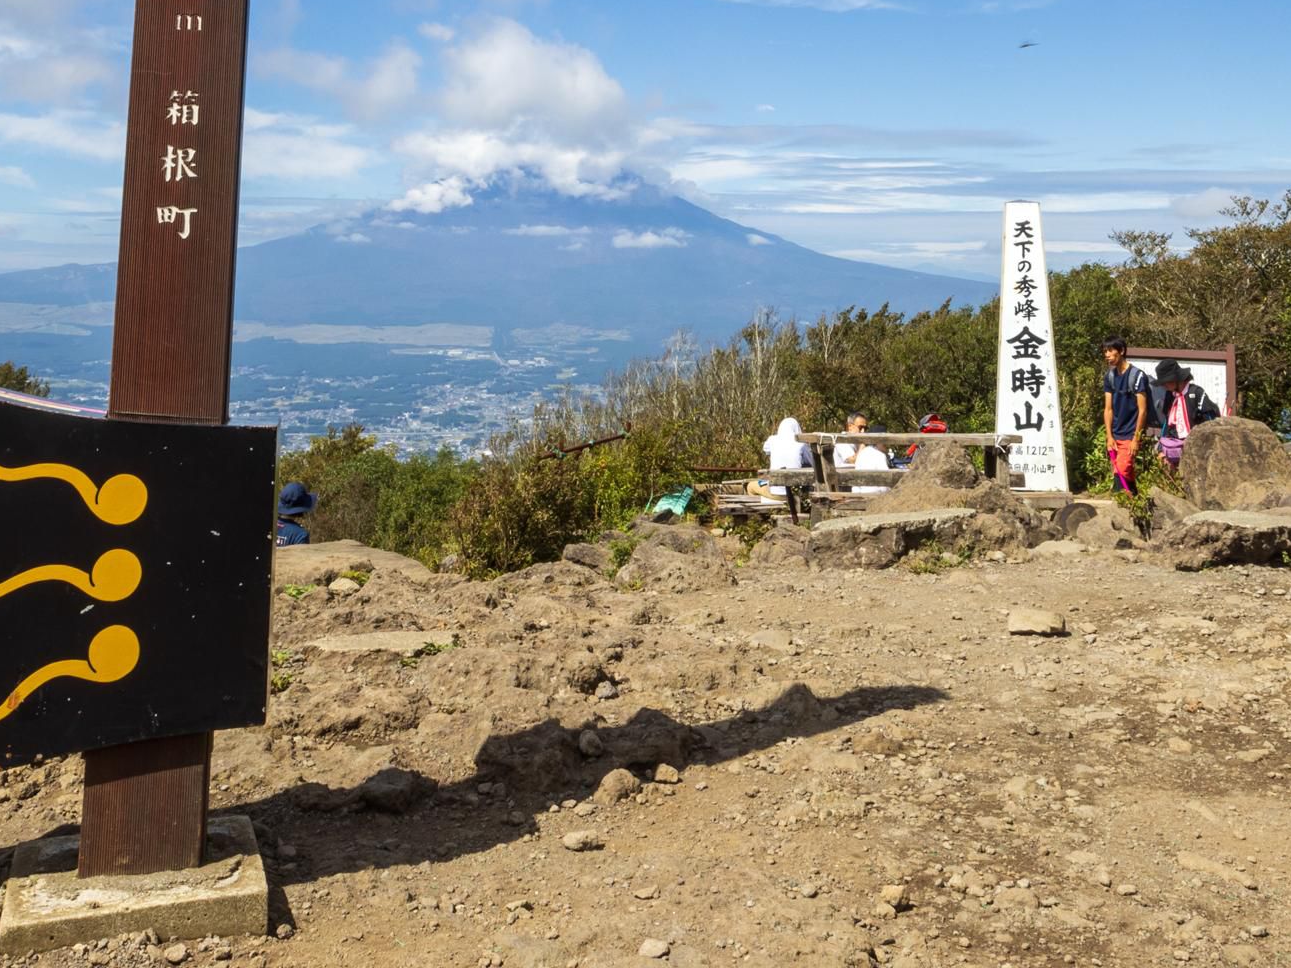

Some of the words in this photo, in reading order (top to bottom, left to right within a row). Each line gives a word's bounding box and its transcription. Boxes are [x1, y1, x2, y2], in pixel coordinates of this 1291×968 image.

[175, 13, 203, 31] m
[156, 90, 200, 240] 箱根町
[1014, 220, 1039, 322] 天下の秀峰
[1007, 326, 1047, 432] 金時山
